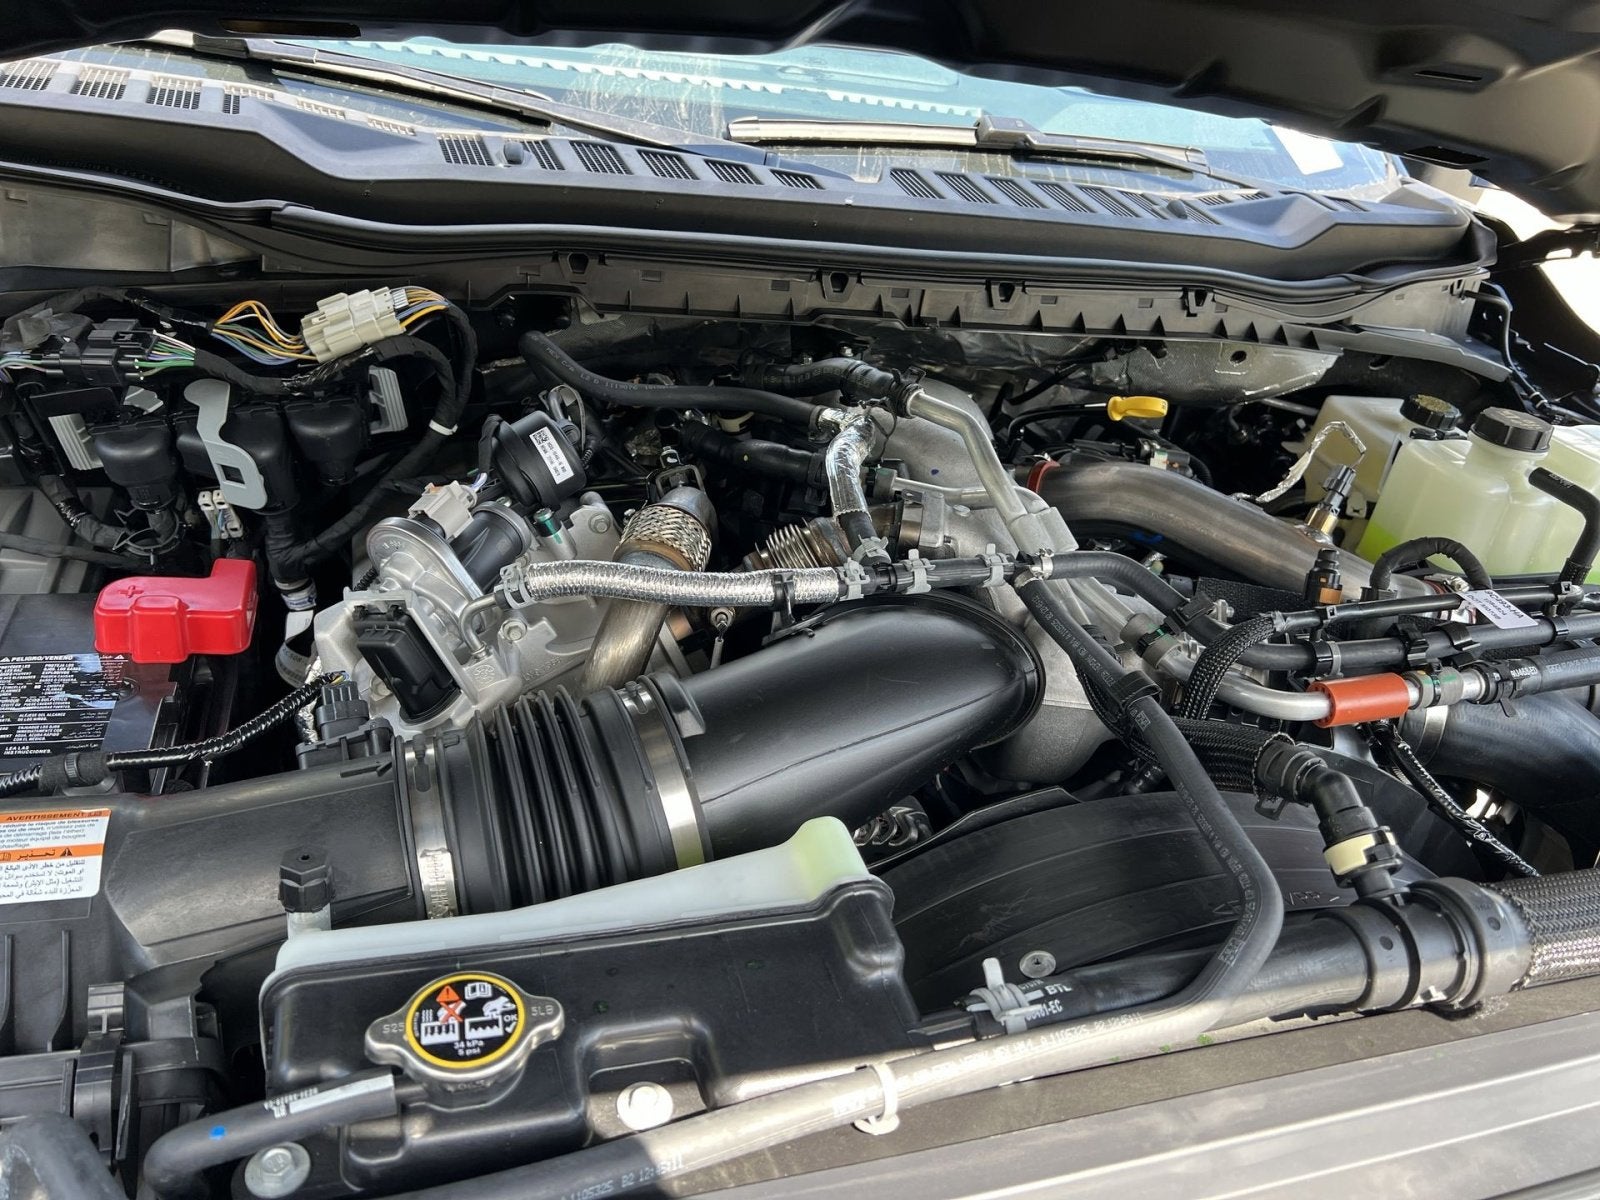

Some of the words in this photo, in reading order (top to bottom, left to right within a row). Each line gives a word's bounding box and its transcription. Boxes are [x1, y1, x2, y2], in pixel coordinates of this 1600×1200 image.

[6, 812, 86, 821] AVERTISSEMENT
[1044, 983, 1072, 995] BTL
[503, 1014, 518, 1022] OK
[453, 1040, 465, 1050] 34
[466, 1039, 485, 1048] kPa
[457, 1048, 465, 1056] 5
[465, 1047, 481, 1056] psi
